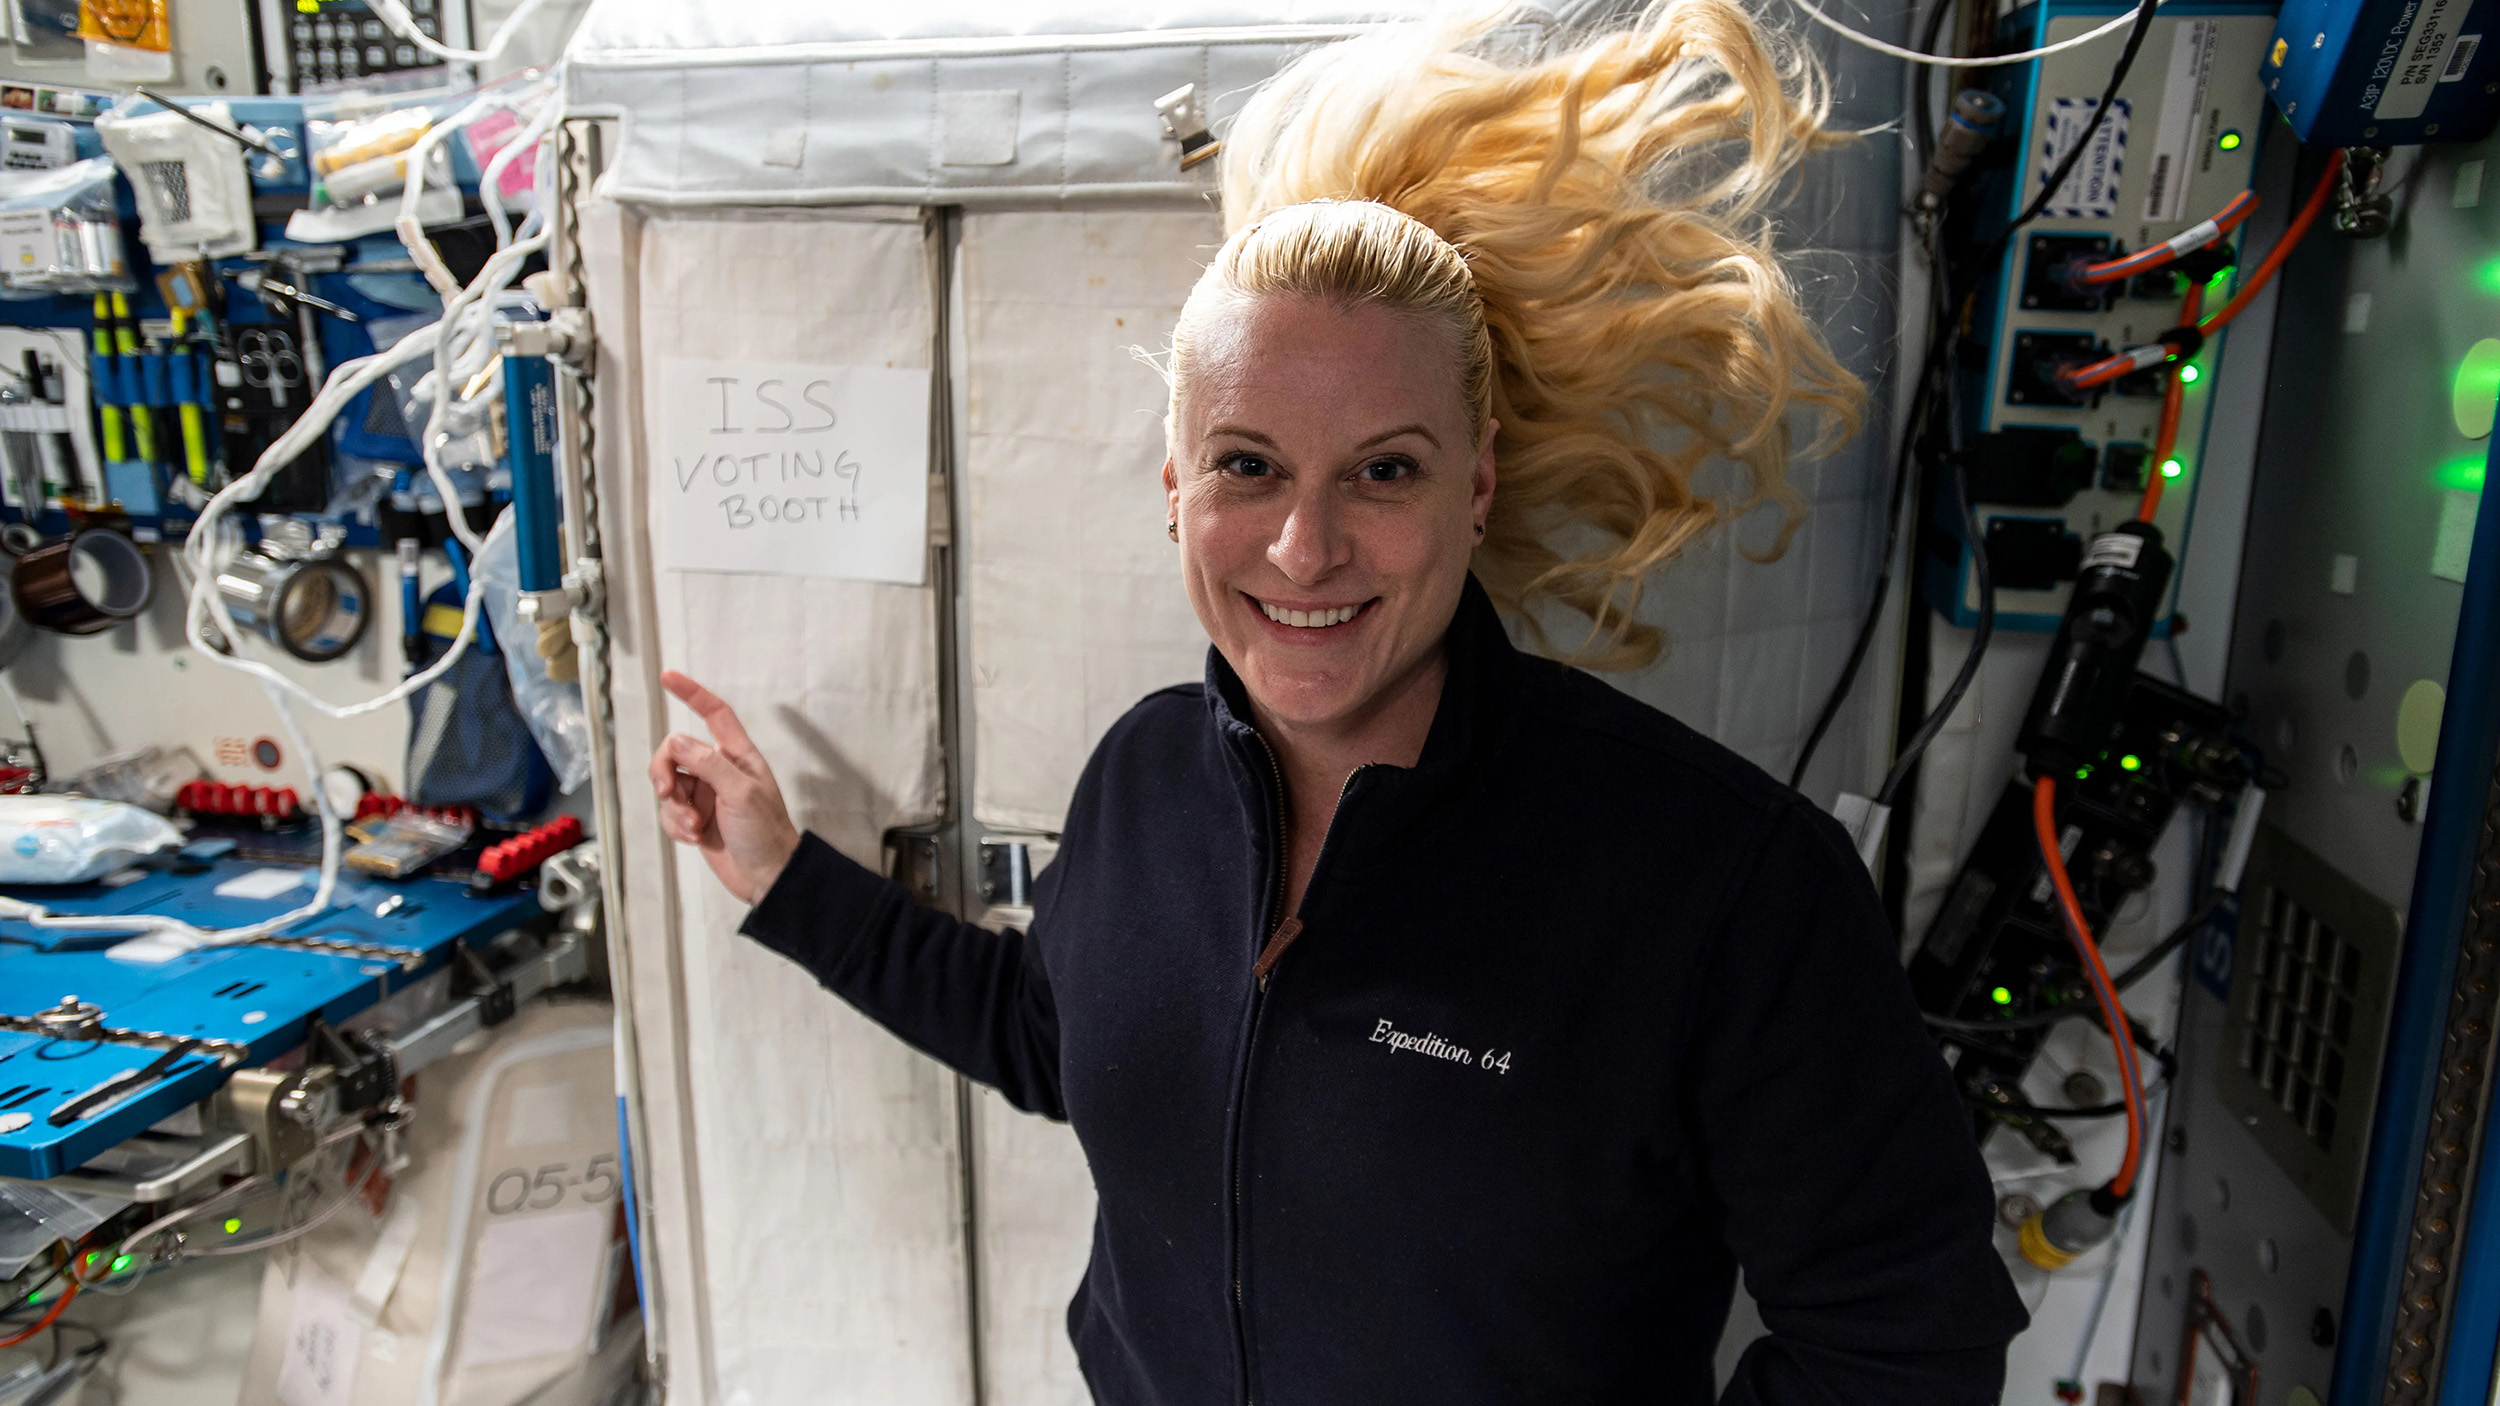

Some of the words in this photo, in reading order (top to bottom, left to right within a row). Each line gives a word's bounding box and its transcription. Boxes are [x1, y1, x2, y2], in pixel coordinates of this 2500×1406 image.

[2391, 1, 2418, 34] Power
[2401, 64, 2418, 85] P/N
[2415, 64, 2433, 84] S/N
[2426, 32, 2448, 60] 1352
[706, 377, 838, 434] ISS
[674, 449, 862, 494] VOTING
[718, 493, 860, 530] BOOTH
[1368, 1018, 1473, 1065] Expedition
[1480, 1048, 1511, 1075] 64
